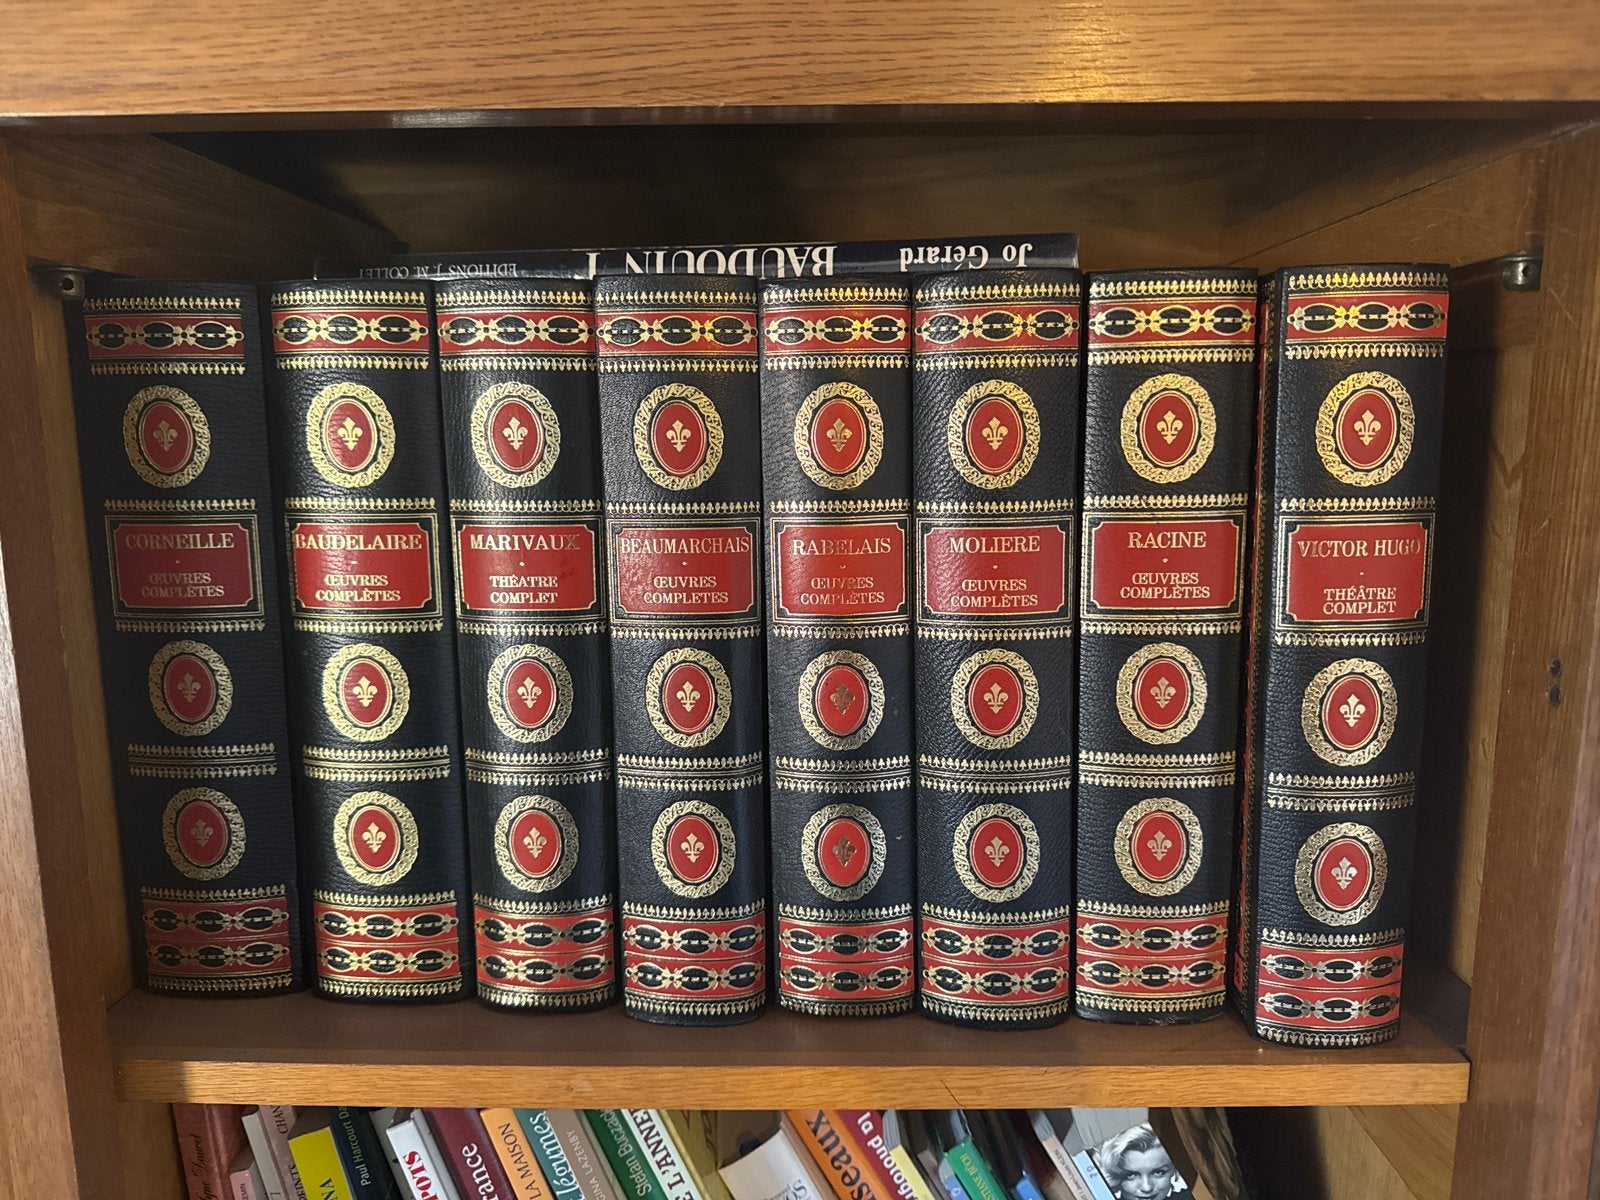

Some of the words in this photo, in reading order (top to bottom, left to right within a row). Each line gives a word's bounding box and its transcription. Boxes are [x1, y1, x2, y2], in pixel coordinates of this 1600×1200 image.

[899, 245, 989, 272] Gérard
[1001, 243, 1033, 268] Jo
[126, 532, 235, 550] CORNEILLE
[295, 534, 422, 551] BAUDELAIRE
[470, 534, 581, 551] MARIVAUX
[620, 536, 750, 555] BEAUMARCHAIS
[792, 538, 892, 556] RABELAIS
[1127, 531, 1207, 549] RACINE
[1297, 540, 1369, 558] VICTOR
[1374, 539, 1421, 557] HUGO
[324, 574, 389, 587] ŒUVRES
[653, 576, 717, 588] ŒUVRES
[961, 579, 1027, 592] ŒUVRES
[1131, 572, 1199, 585] ŒUVRES
[315, 588, 401, 602] COMPLÈTES
[490, 592, 558, 604] COMPLET
[950, 594, 1038, 608] COMPLÈTES
[1120, 585, 1210, 599] COMPLÈTES
[1323, 585, 1397, 601] THÉÂTRE
[1323, 601, 1397, 615] COMPLET
[857, 1111, 874, 1135] la
[342, 1121, 364, 1163] Harcourt
[499, 1122, 533, 1179] MAISON
[566, 1130, 593, 1175] LAZENBY
[355, 1164, 372, 1187] Paul
[626, 1156, 652, 1196] Stefan
